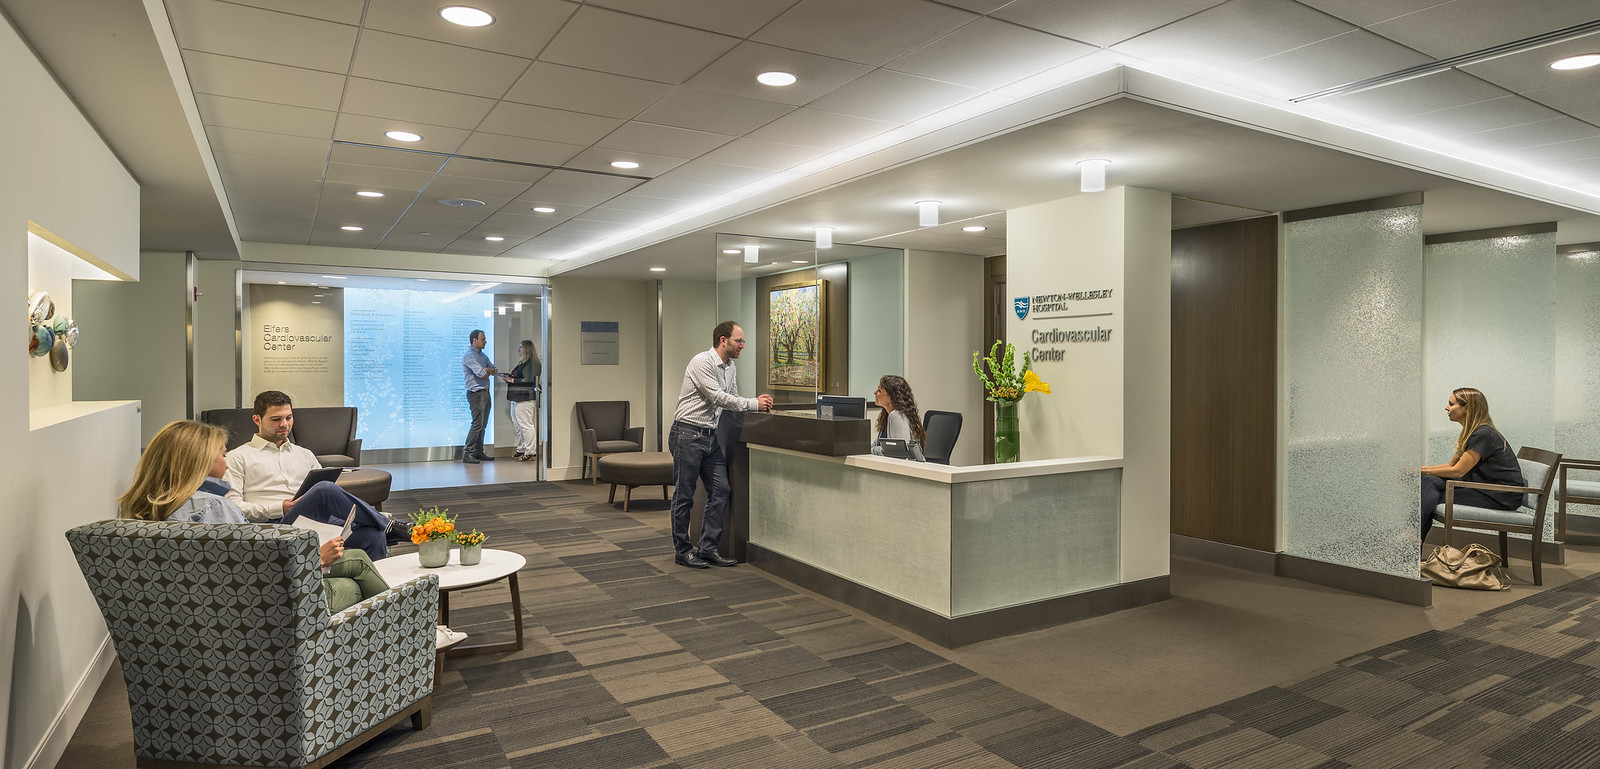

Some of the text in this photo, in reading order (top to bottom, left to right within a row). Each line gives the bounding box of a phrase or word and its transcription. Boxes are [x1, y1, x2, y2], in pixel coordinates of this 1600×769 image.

[1032, 289, 1113, 304] NEWTON-WELLESLEY
[1032, 302, 1069, 313] HOSPITAL
[263, 324, 290, 333] Elfers
[263, 333, 333, 343] Cardiovascular
[1031, 326, 1113, 344] Cardiovascular
[263, 342, 296, 351] Center
[1031, 346, 1066, 362] Center
